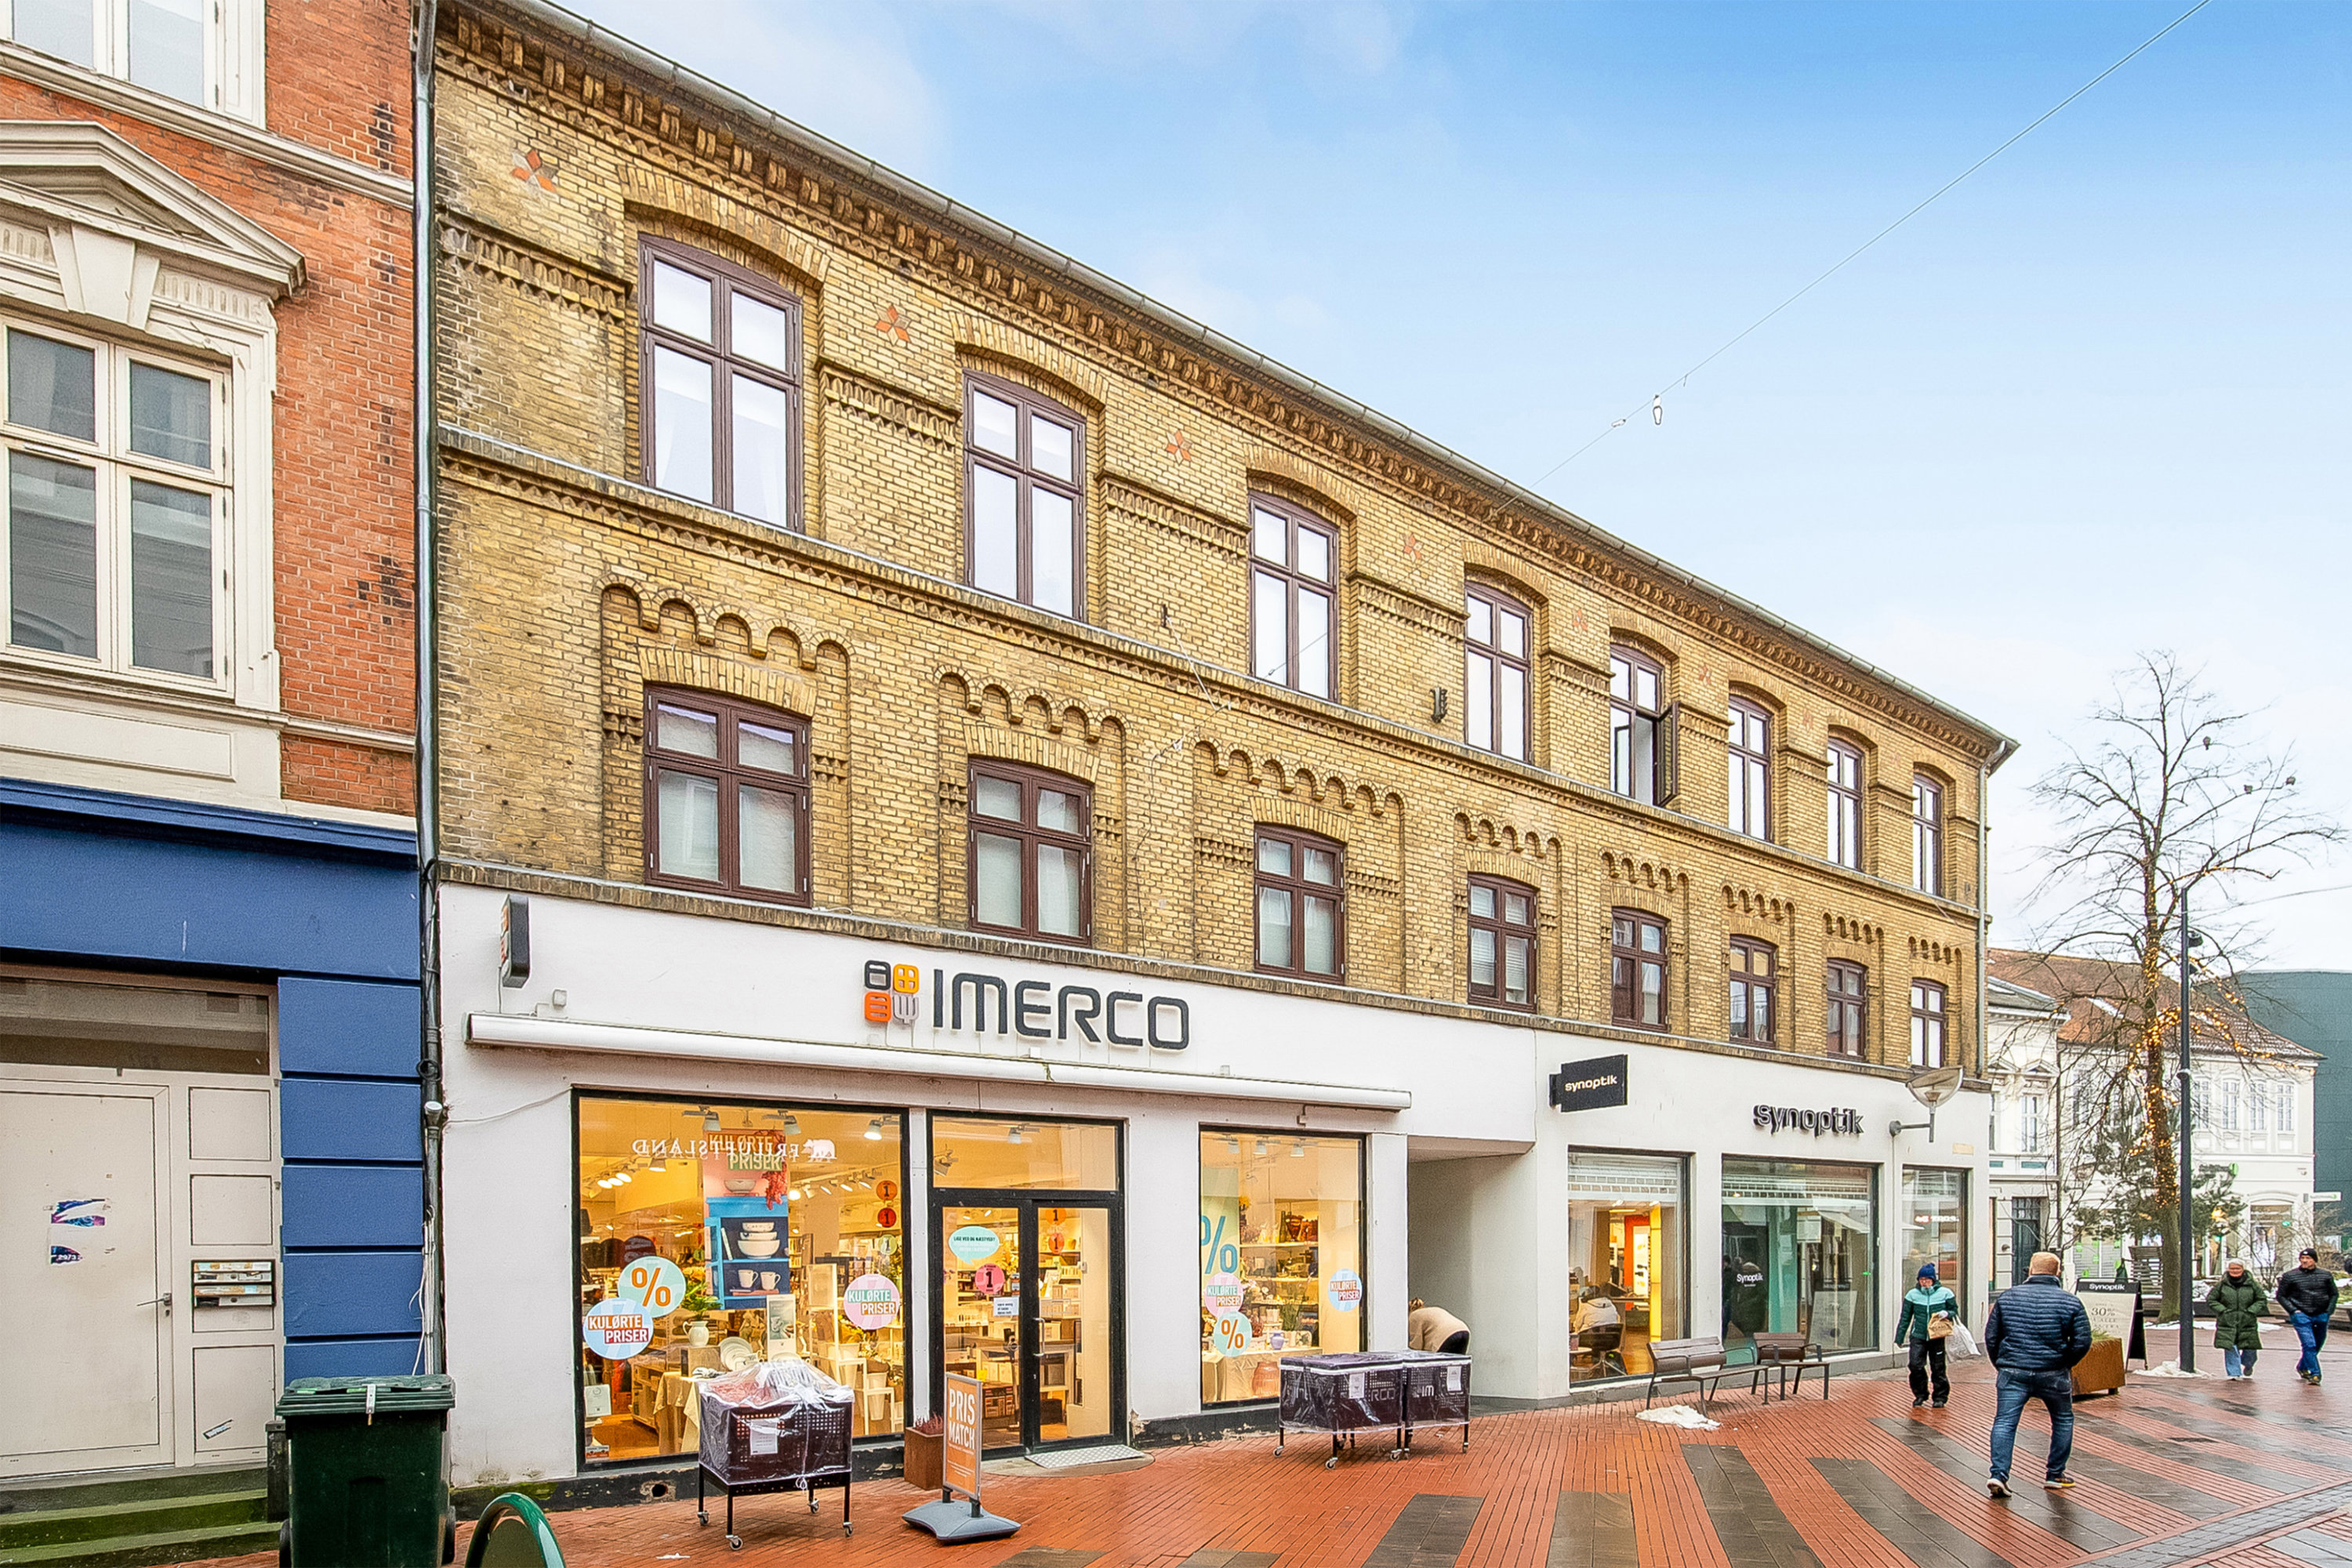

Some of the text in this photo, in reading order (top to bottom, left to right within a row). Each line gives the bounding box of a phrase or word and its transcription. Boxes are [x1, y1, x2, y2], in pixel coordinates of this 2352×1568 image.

[933, 969, 1189, 1050] IMERCO
[1565, 1075, 1617, 1092] synoptik
[1753, 1105, 1864, 1138] synoptik
[985, 1271, 993, 1288] 1
[848, 1290, 891, 1302] KULØRTE
[1217, 1296, 1241, 1306] PRISER
[1338, 1290, 1359, 1301] PRISER
[862, 1302, 895, 1315] PRISER
[589, 1315, 642, 1330] KULØRTE
[606, 1328, 648, 1343] PRISER
[949, 1388, 975, 1425] PRIS
[948, 1420, 975, 1450] MATCH
